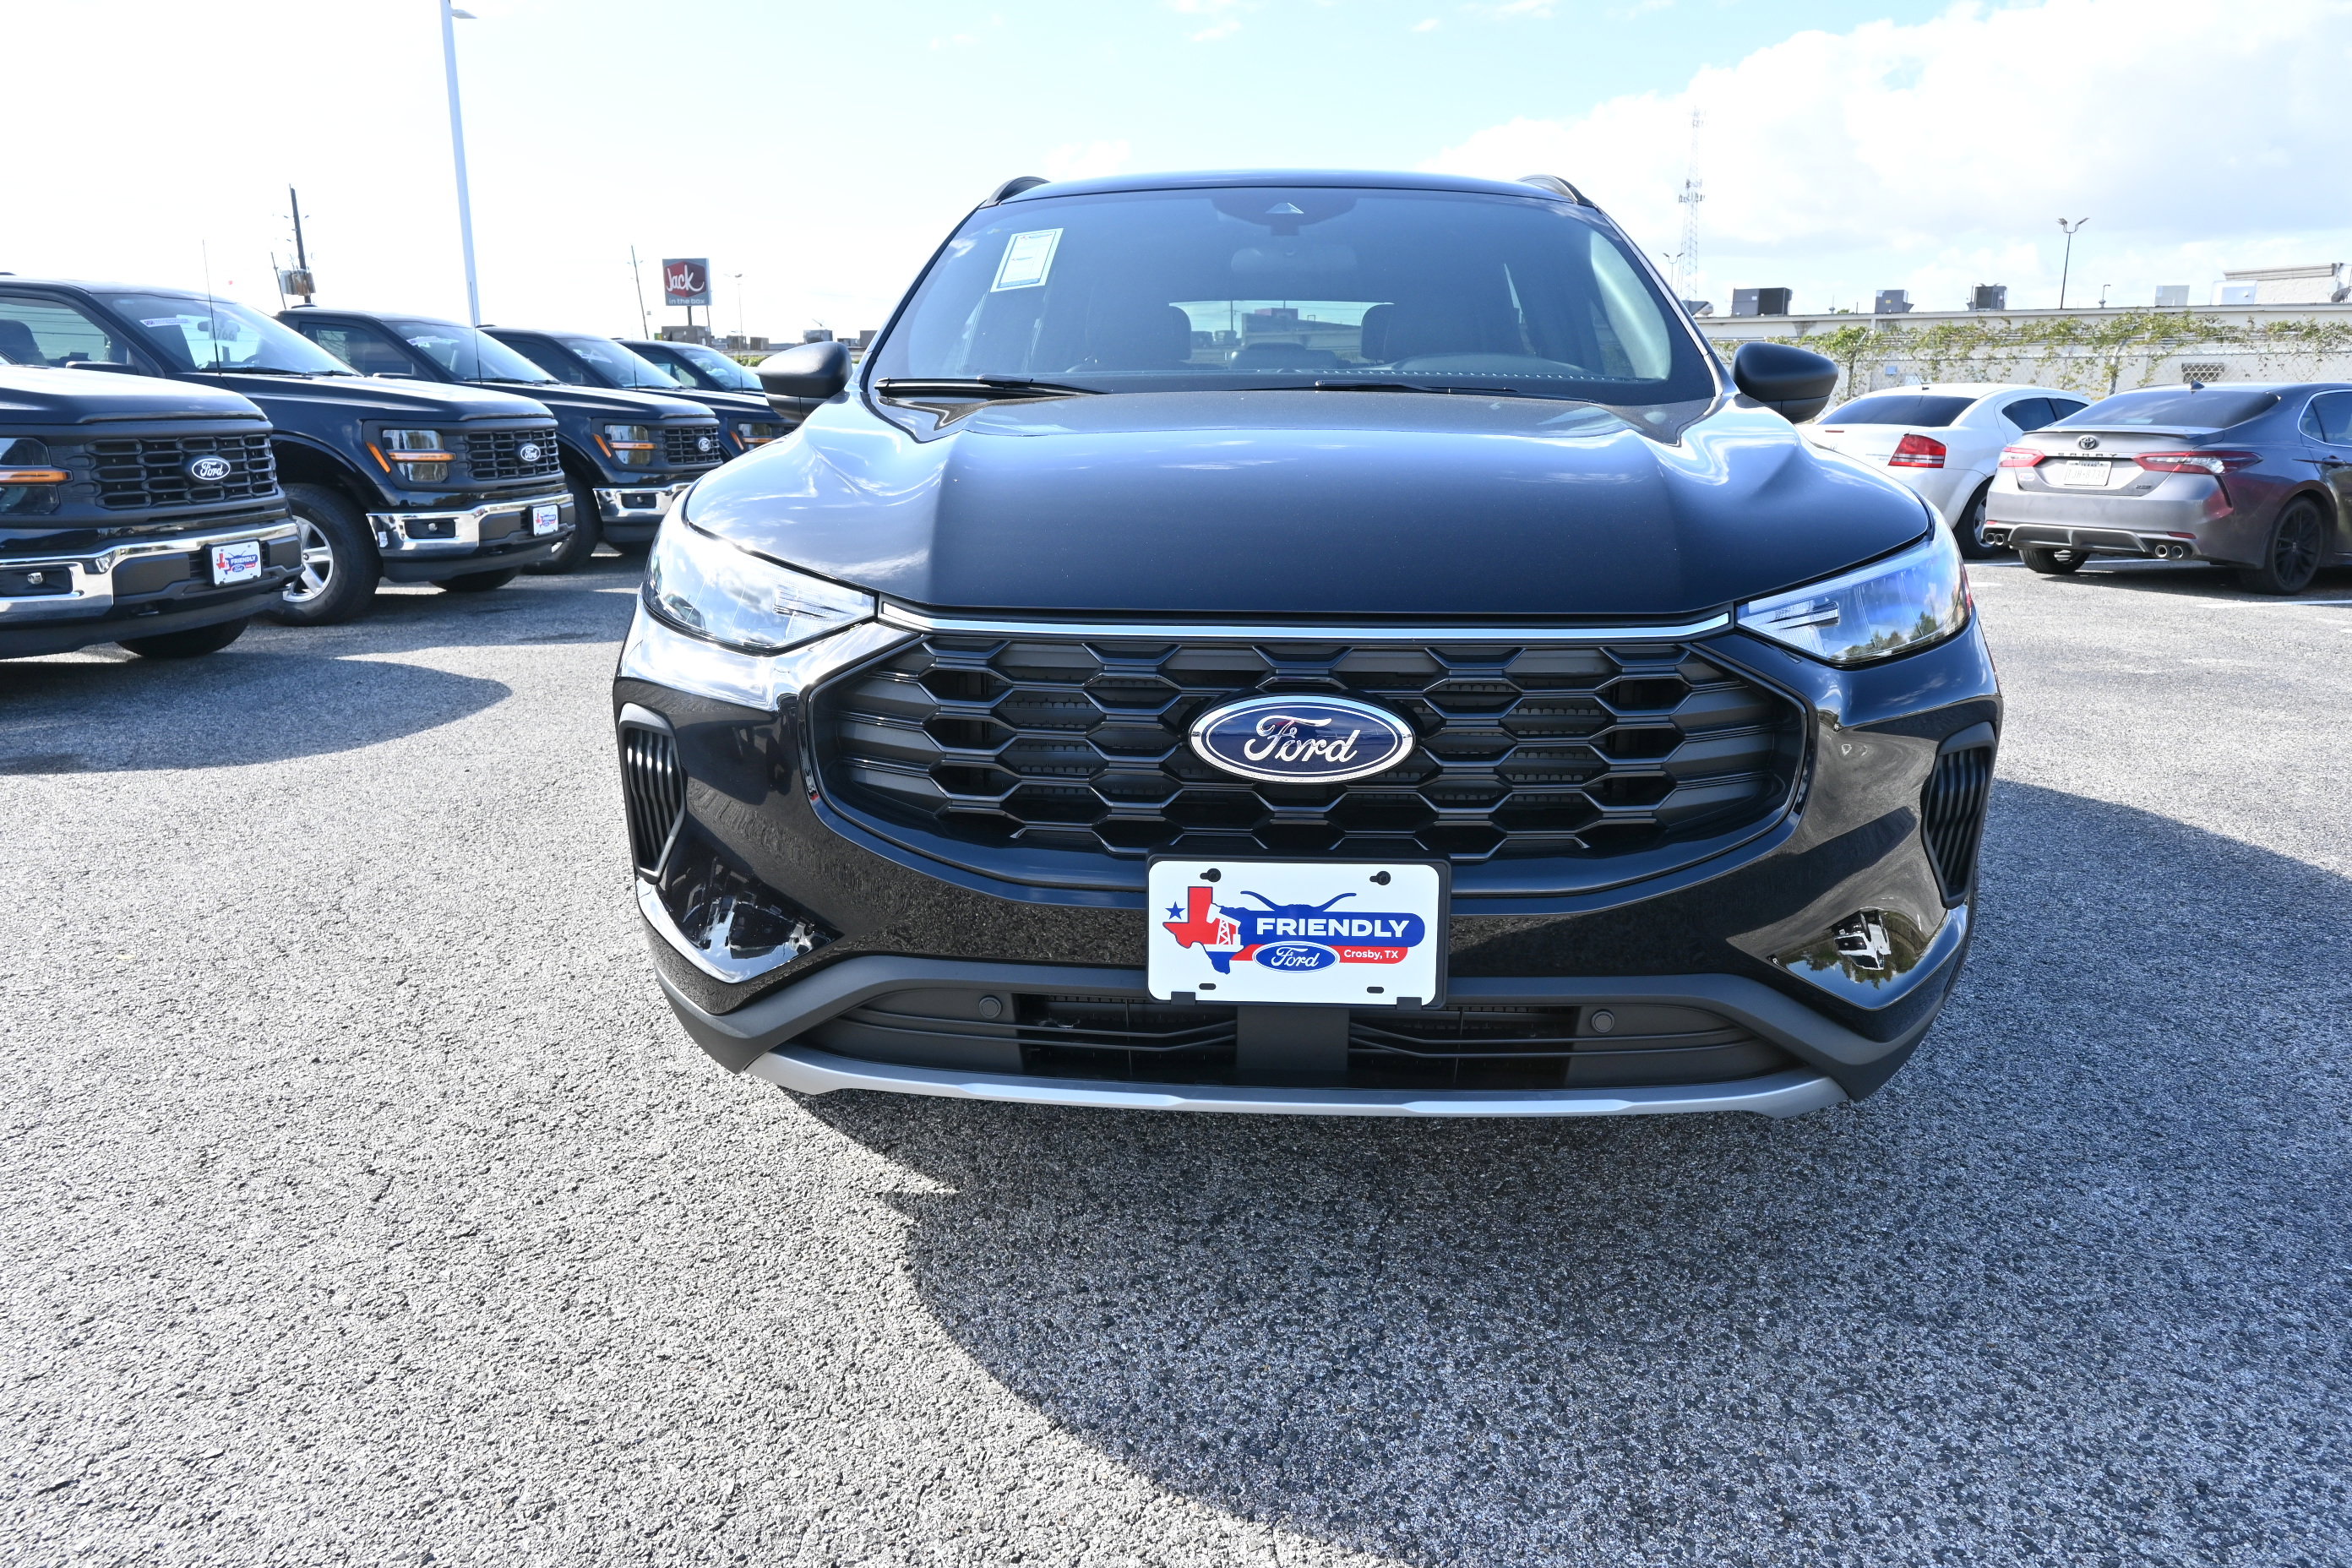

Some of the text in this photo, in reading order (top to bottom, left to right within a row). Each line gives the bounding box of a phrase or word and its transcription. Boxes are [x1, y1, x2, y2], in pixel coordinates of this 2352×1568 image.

[667, 264, 705, 292] Jack
[525, 447, 537, 459] Ford
[199, 461, 224, 477] Ford
[231, 555, 256, 565] FRIENDLY
[1244, 715, 1362, 763] Ford
[1256, 917, 1410, 938] FRIENDLY
[1271, 945, 1320, 968] Ford
[1343, 949, 1399, 960] Crosby, TX
